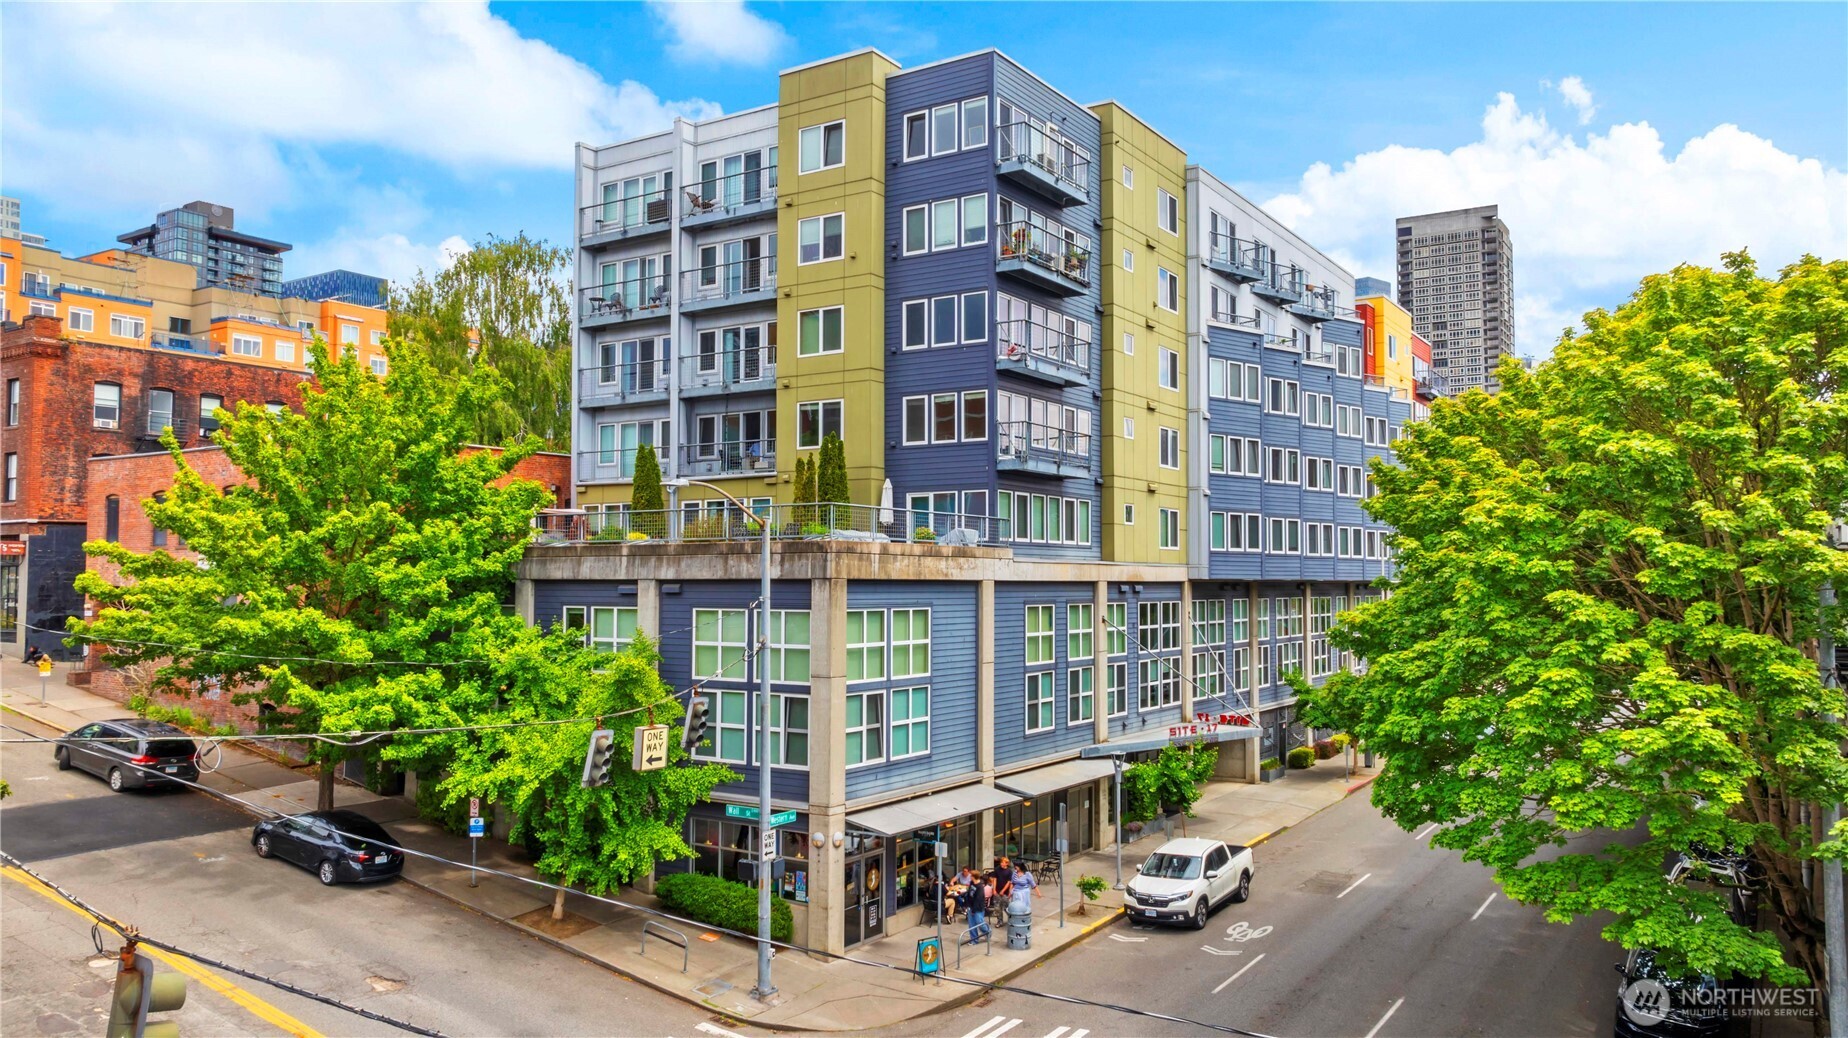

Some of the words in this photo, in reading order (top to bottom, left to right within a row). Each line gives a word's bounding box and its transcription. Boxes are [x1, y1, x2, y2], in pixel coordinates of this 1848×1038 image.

[1169, 725, 1197, 737] SITE
[1207, 723, 1218, 733] 17
[647, 731, 664, 742] ONE
[646, 742, 664, 753] WAY
[728, 806, 740, 816] Wall
[764, 832, 775, 842] ONE
[764, 841, 775, 850] WAY
